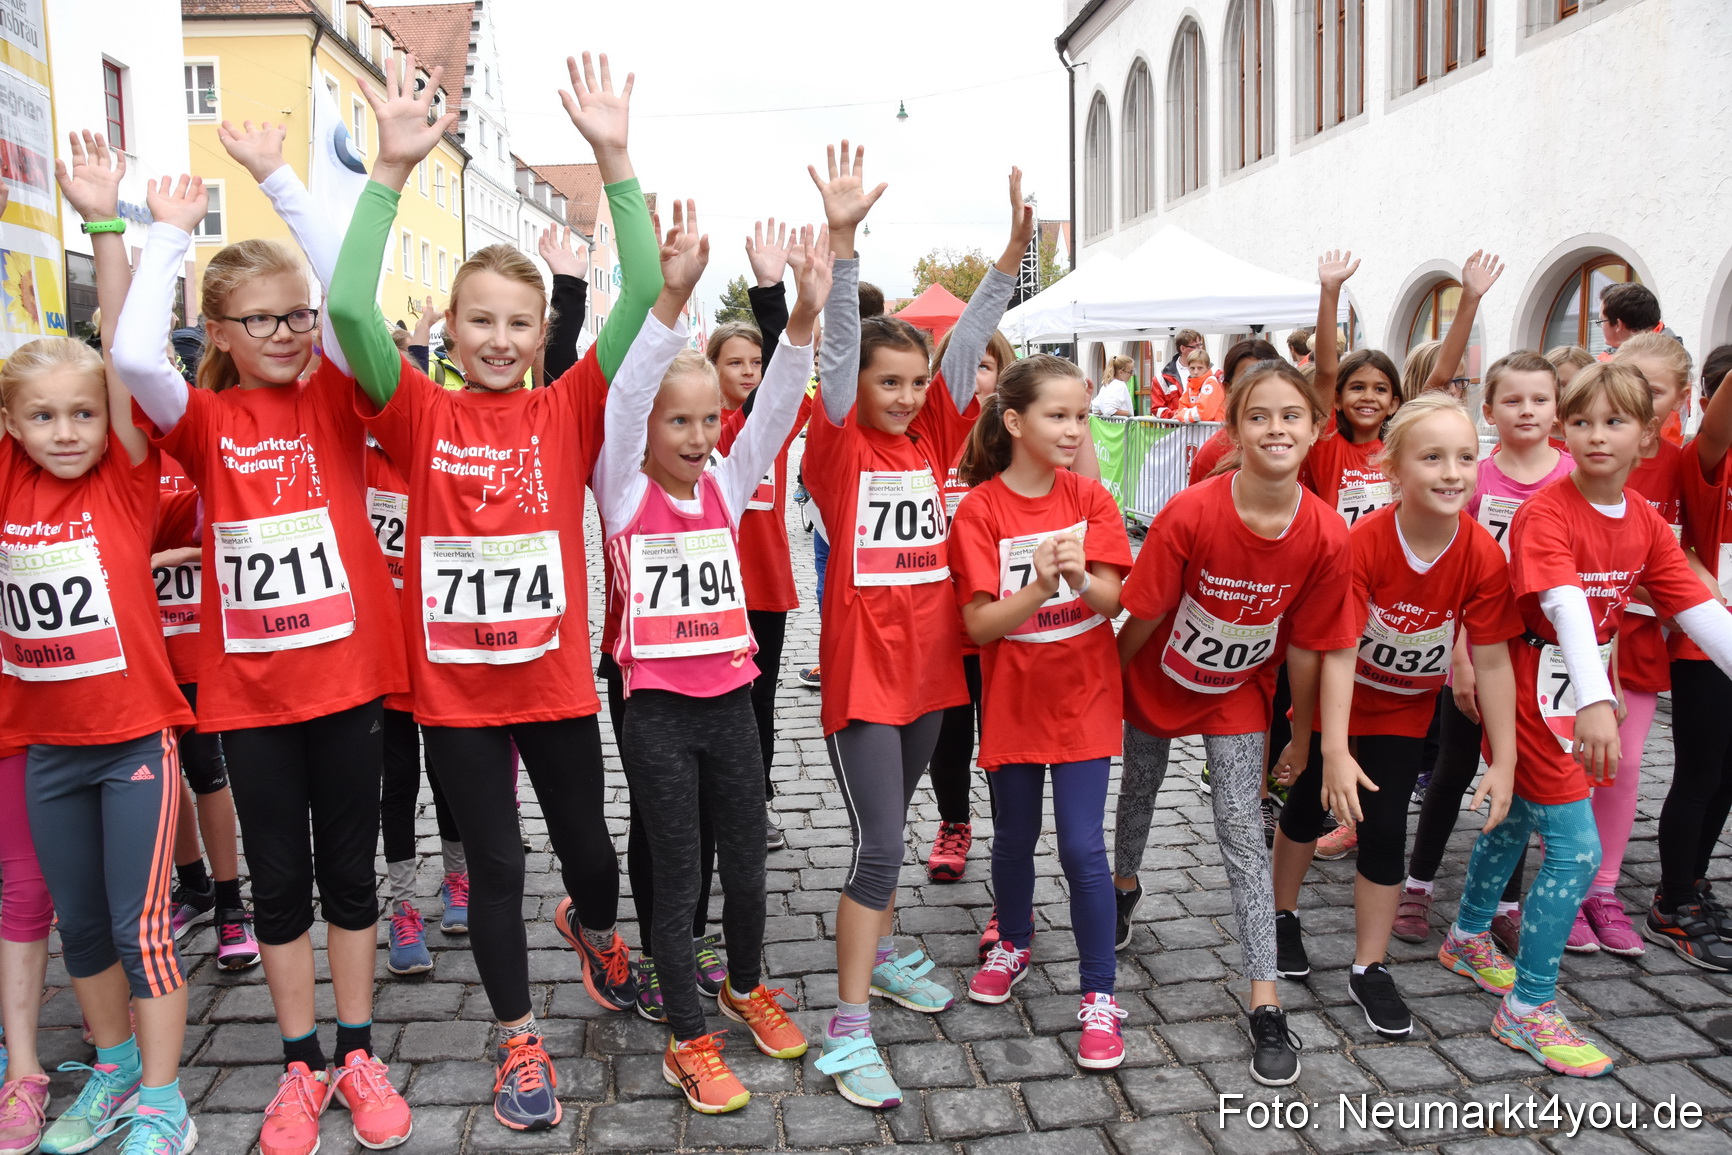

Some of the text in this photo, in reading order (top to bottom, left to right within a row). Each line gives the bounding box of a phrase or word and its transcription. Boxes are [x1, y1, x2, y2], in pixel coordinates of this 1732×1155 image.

[531, 435, 549, 513] BAMBINI
[260, 514, 323, 539] BOCK
[869, 496, 945, 541] 7038
[482, 536, 548, 556] BOCK
[641, 548, 679, 556] NeuerMarkt
[685, 533, 728, 551] BOCK
[10, 546, 84, 571] BOCK
[433, 551, 475, 559] NeuerMarkt
[895, 552, 937, 569] Alicia
[224, 542, 333, 601] 7211
[1200, 568, 1276, 593] Neumarkter
[437, 564, 553, 615] 7174
[645, 559, 735, 609] 7194
[1198, 580, 1257, 604] Stadtlauf
[262, 613, 310, 633] Lena
[1037, 605, 1082, 628] Melina
[474, 628, 518, 646] Lena
[676, 620, 719, 638] Alina
[1220, 624, 1277, 638] BOCK
[1394, 625, 1449, 646] BOCK
[14, 644, 76, 667] Sophia
[1181, 619, 1271, 669] 7202
[1358, 634, 1446, 673] 7032
[1194, 670, 1235, 685] Lucia
[1361, 664, 1413, 688] Sophie
